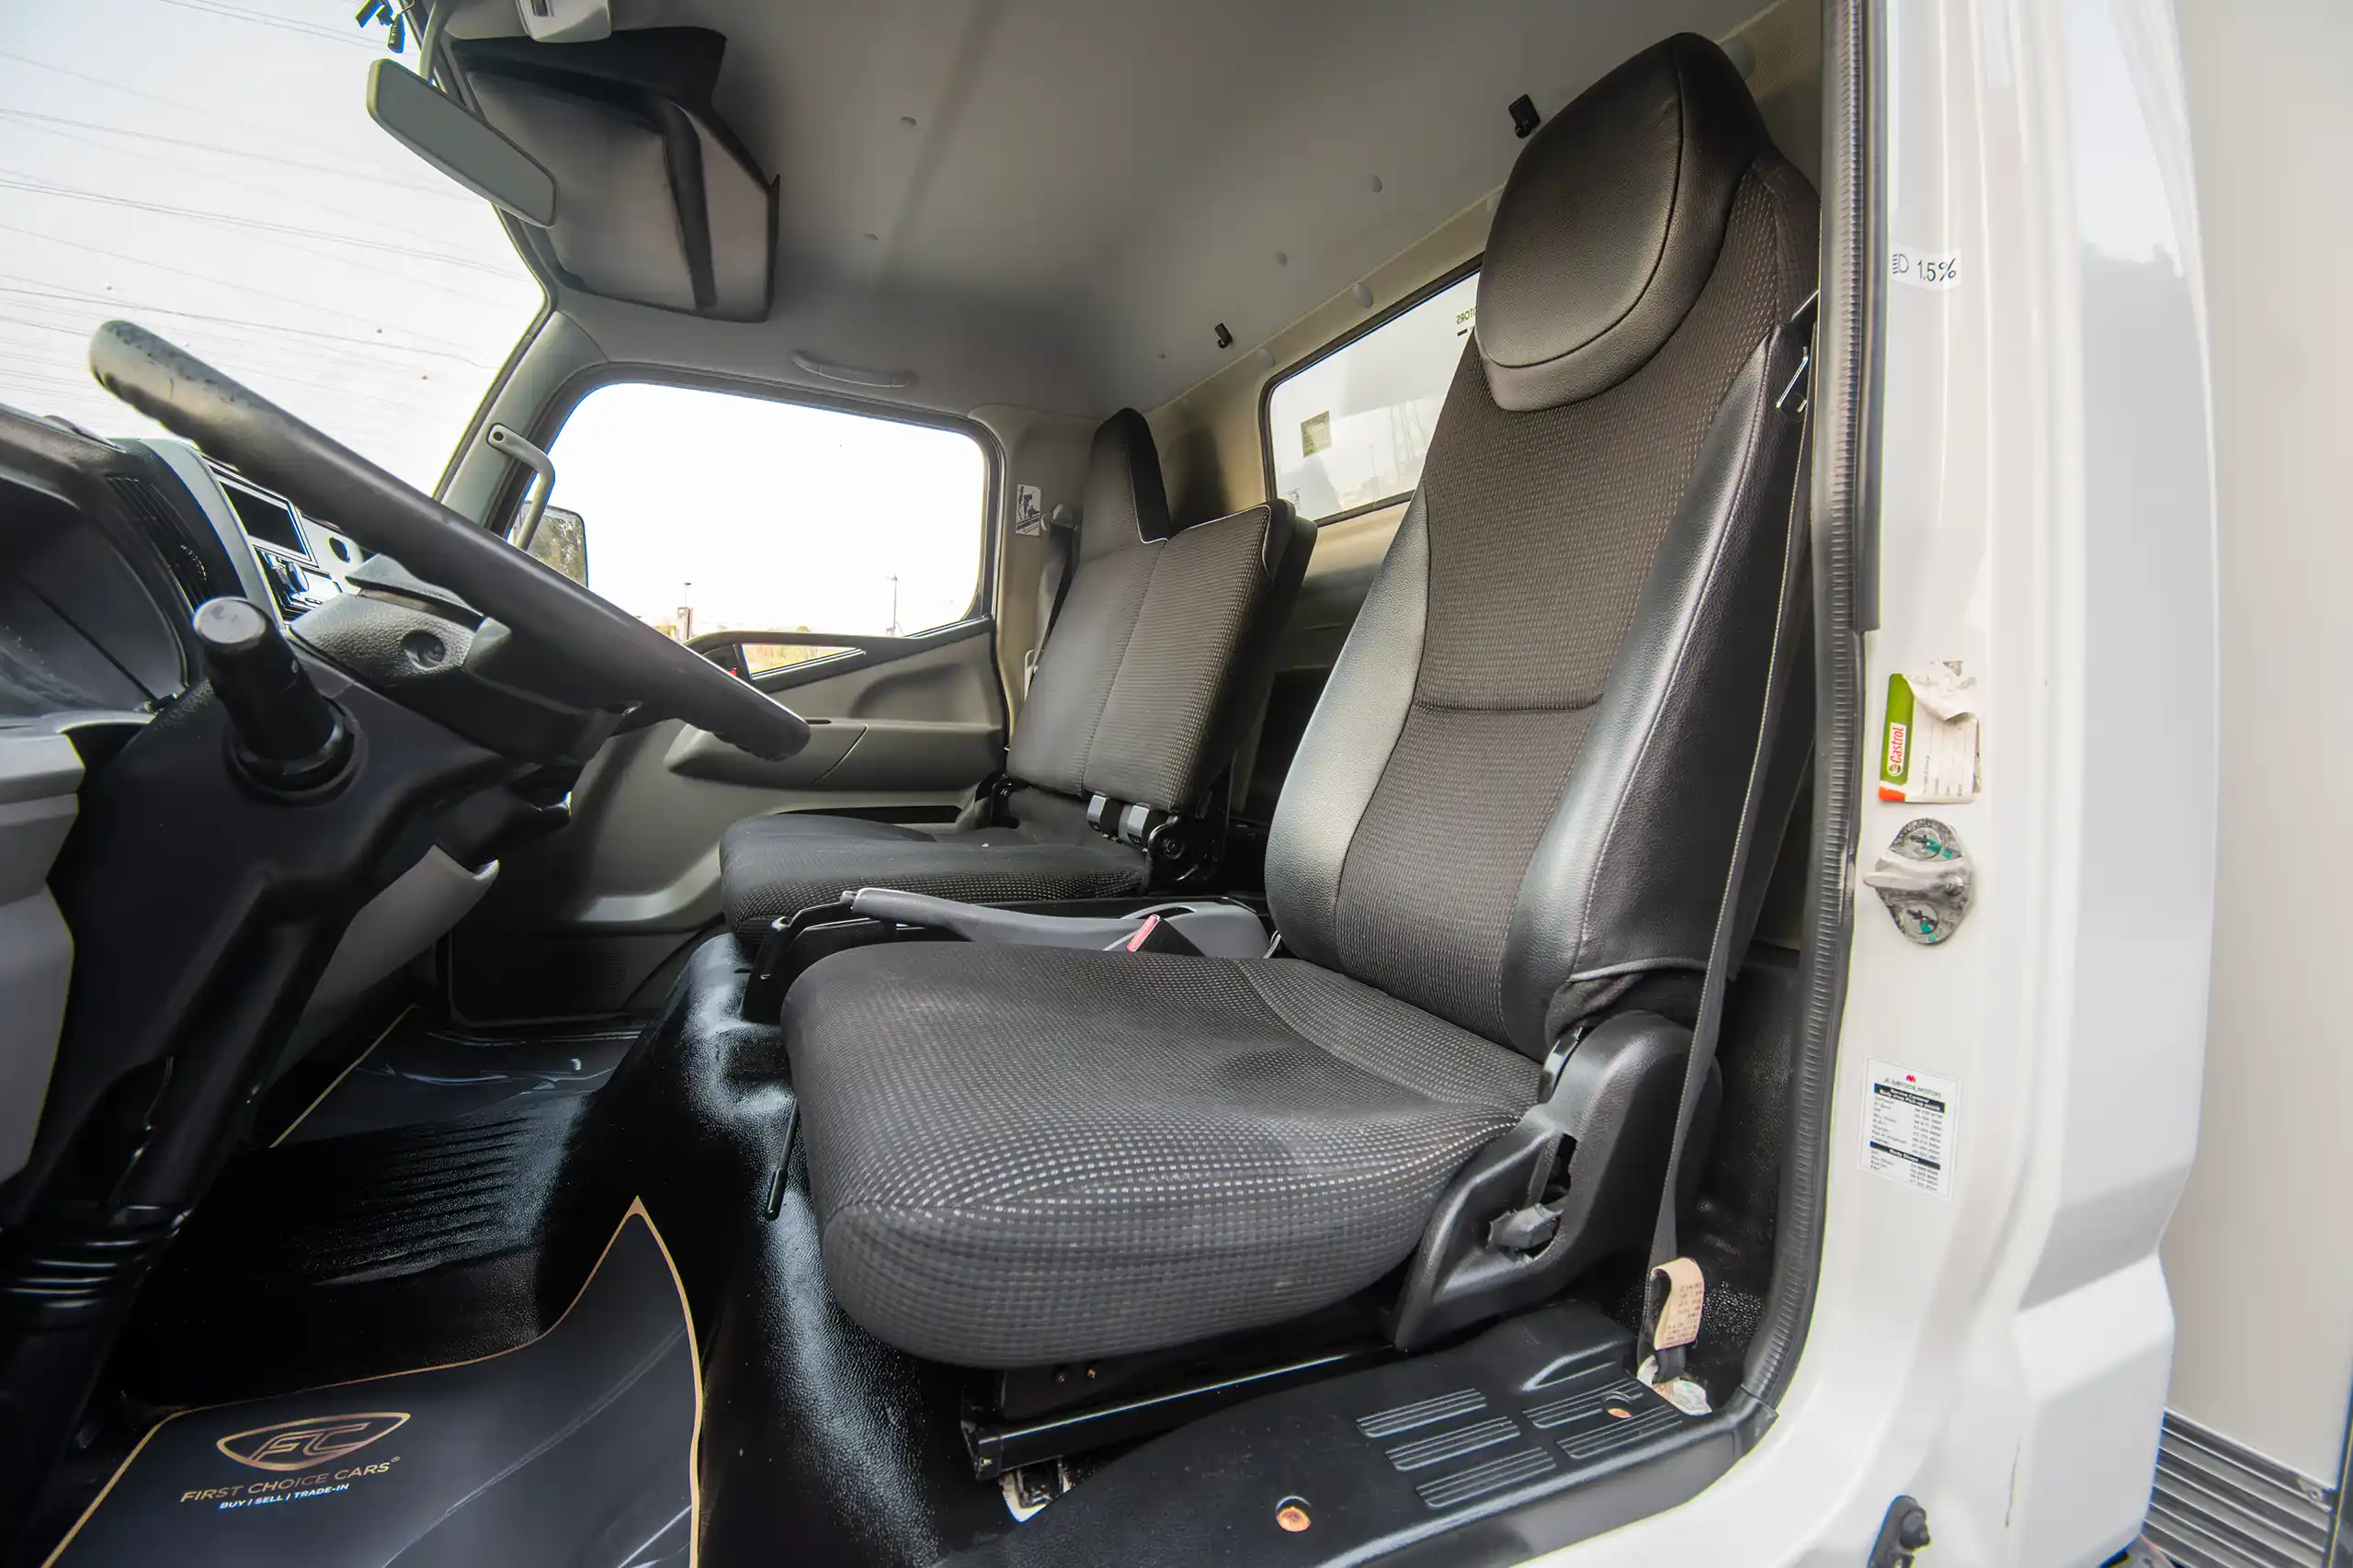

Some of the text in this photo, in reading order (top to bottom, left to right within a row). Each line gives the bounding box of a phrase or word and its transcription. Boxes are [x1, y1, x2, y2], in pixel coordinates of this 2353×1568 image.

[1890, 727, 1904, 764] Castrol
[180, 1485, 244, 1503] FIRST
[247, 1473, 330, 1494] CHOICE
[219, 1498, 247, 1510] BUY
[254, 1494, 284, 1505] SELL
[293, 1483, 350, 1499] TRADE-IN
